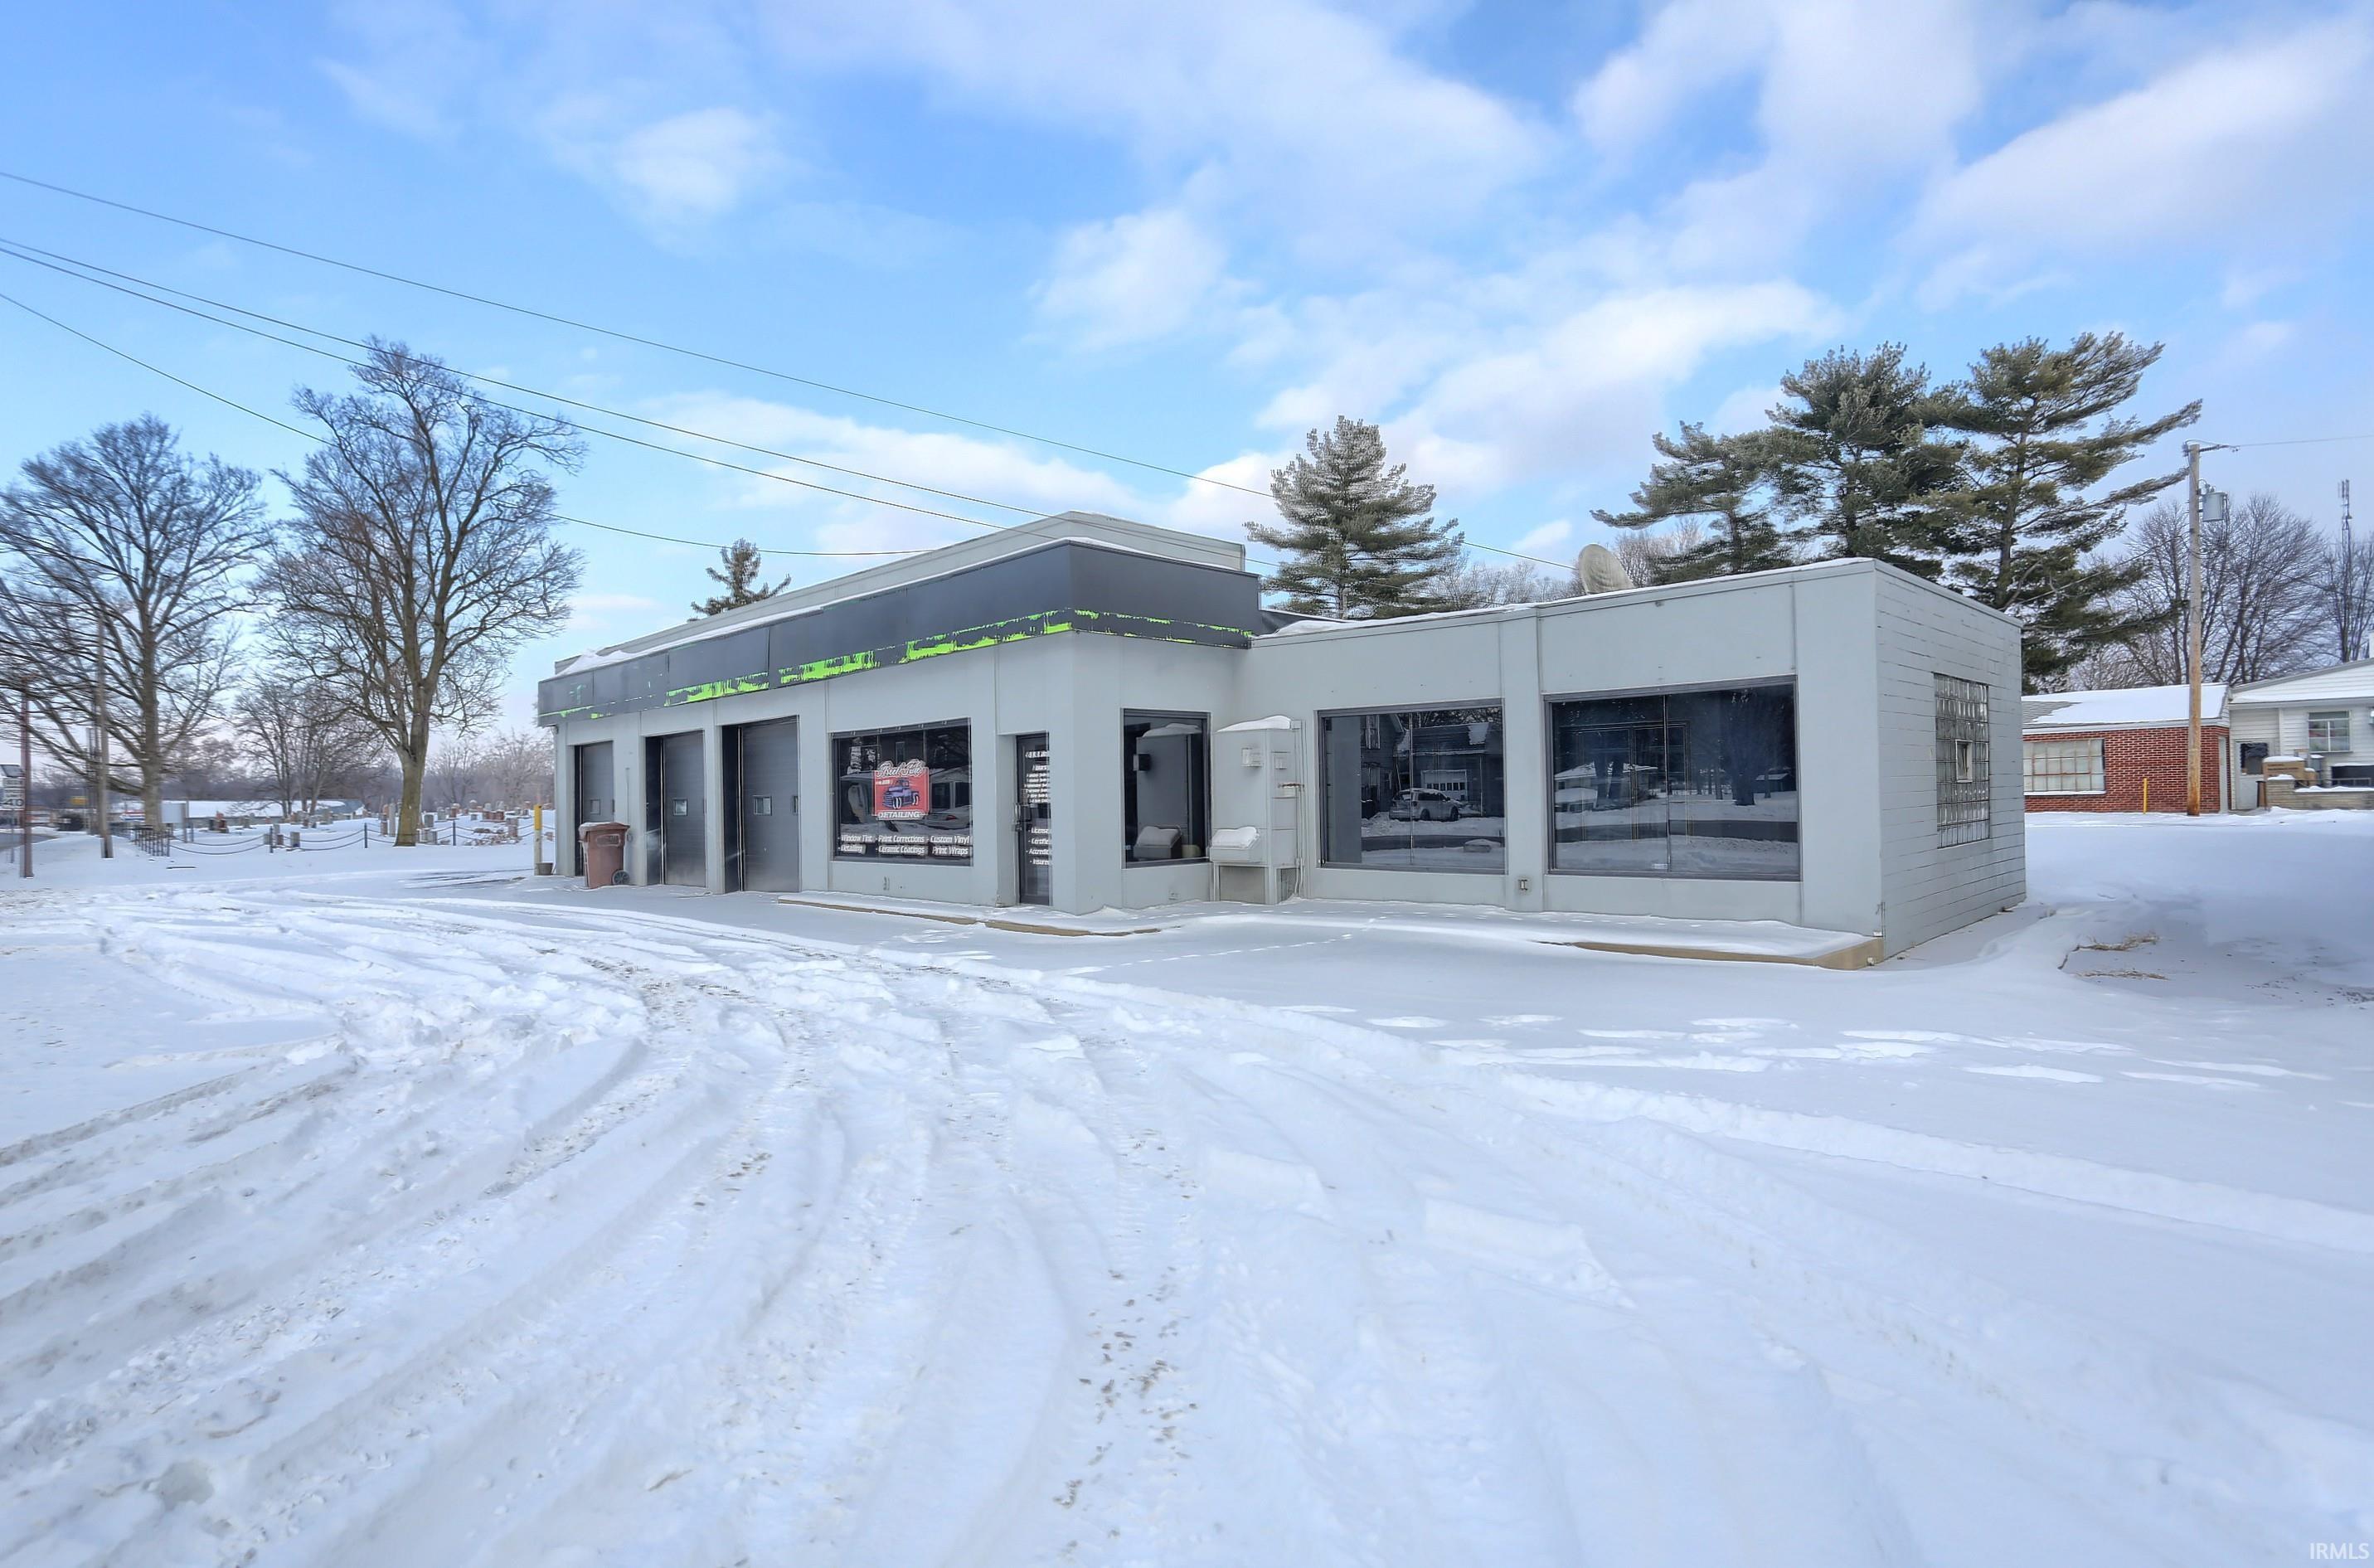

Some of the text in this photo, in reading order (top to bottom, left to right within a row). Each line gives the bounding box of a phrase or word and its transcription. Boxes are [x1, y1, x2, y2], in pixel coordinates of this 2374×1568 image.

[841, 834, 862, 842] Window
[878, 834, 925, 843] Paint Corrections
[930, 835, 970, 845] Custom Vinyl
[879, 845, 925, 855] Ceramic Coatings
[932, 846, 969, 856] Print Wraps
